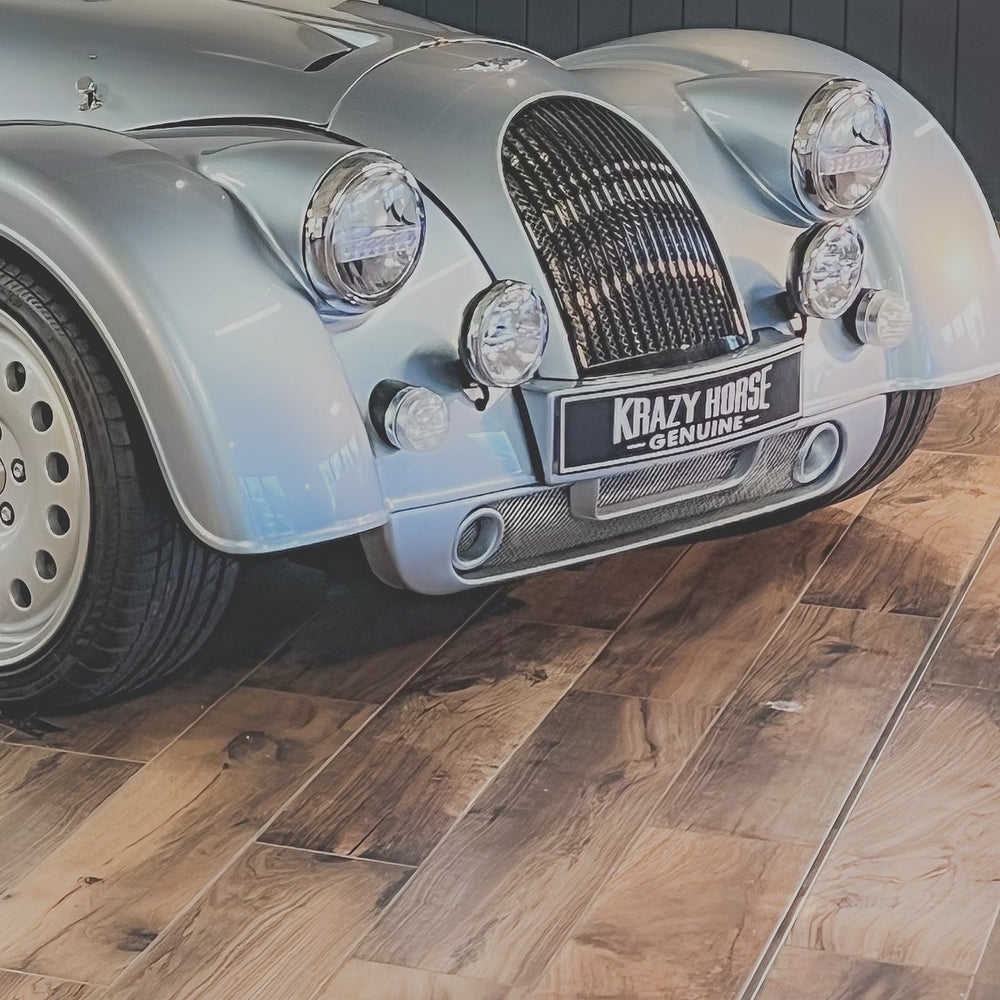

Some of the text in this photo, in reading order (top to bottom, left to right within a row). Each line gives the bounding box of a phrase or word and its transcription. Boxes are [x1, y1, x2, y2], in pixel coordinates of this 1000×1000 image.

[613, 365, 772, 444] KRAZY HORSE
[649, 416, 743, 449] GENUINE
